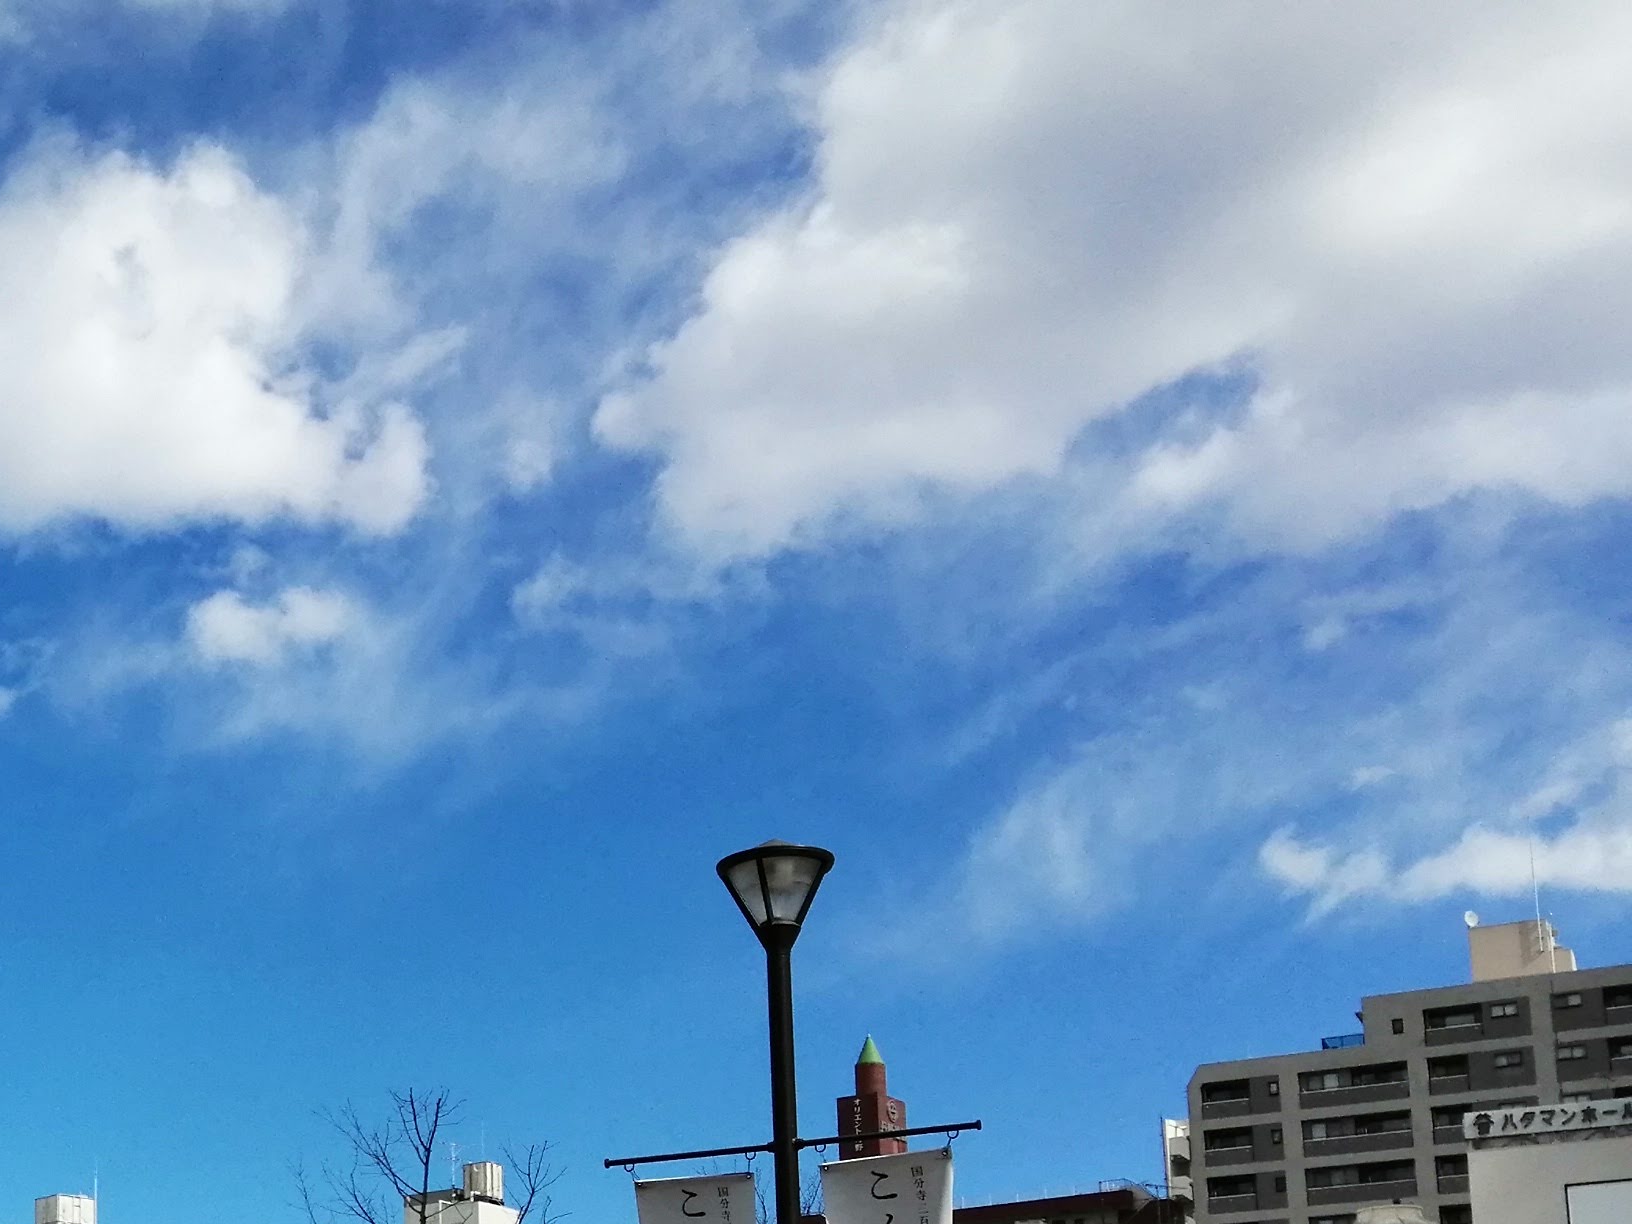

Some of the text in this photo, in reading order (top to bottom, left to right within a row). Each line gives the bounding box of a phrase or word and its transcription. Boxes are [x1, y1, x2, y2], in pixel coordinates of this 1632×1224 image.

[853, 1099, 864, 1152] オリエント野
